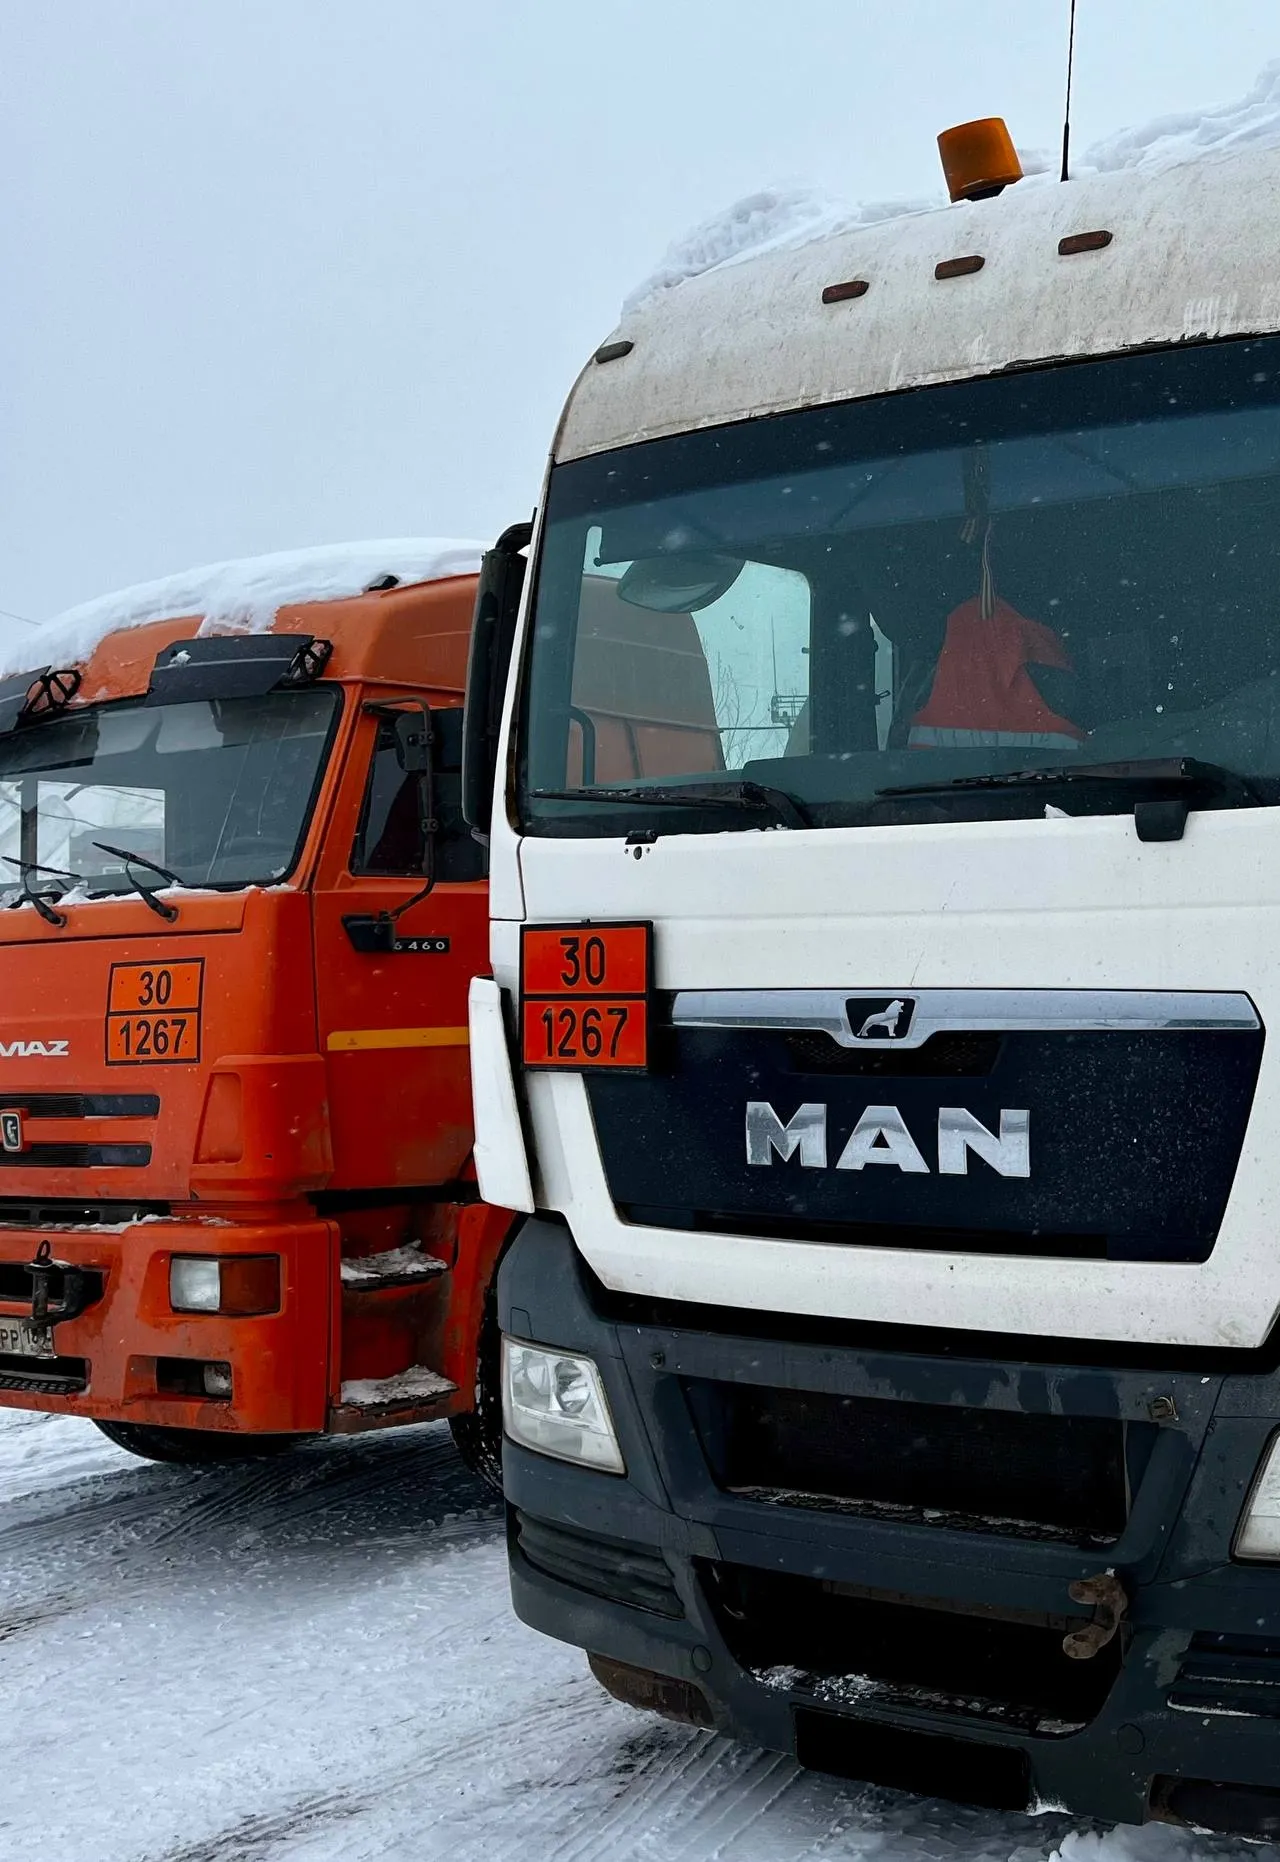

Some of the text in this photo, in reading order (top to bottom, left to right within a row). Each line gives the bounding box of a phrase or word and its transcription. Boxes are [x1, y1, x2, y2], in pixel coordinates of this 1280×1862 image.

[560, 936, 606, 986] 30
[138, 970, 171, 1006] 30
[119, 1018, 187, 1056] 1267
[541, 1007, 628, 1058] 1267
[746, 1101, 1031, 1179] MAN
